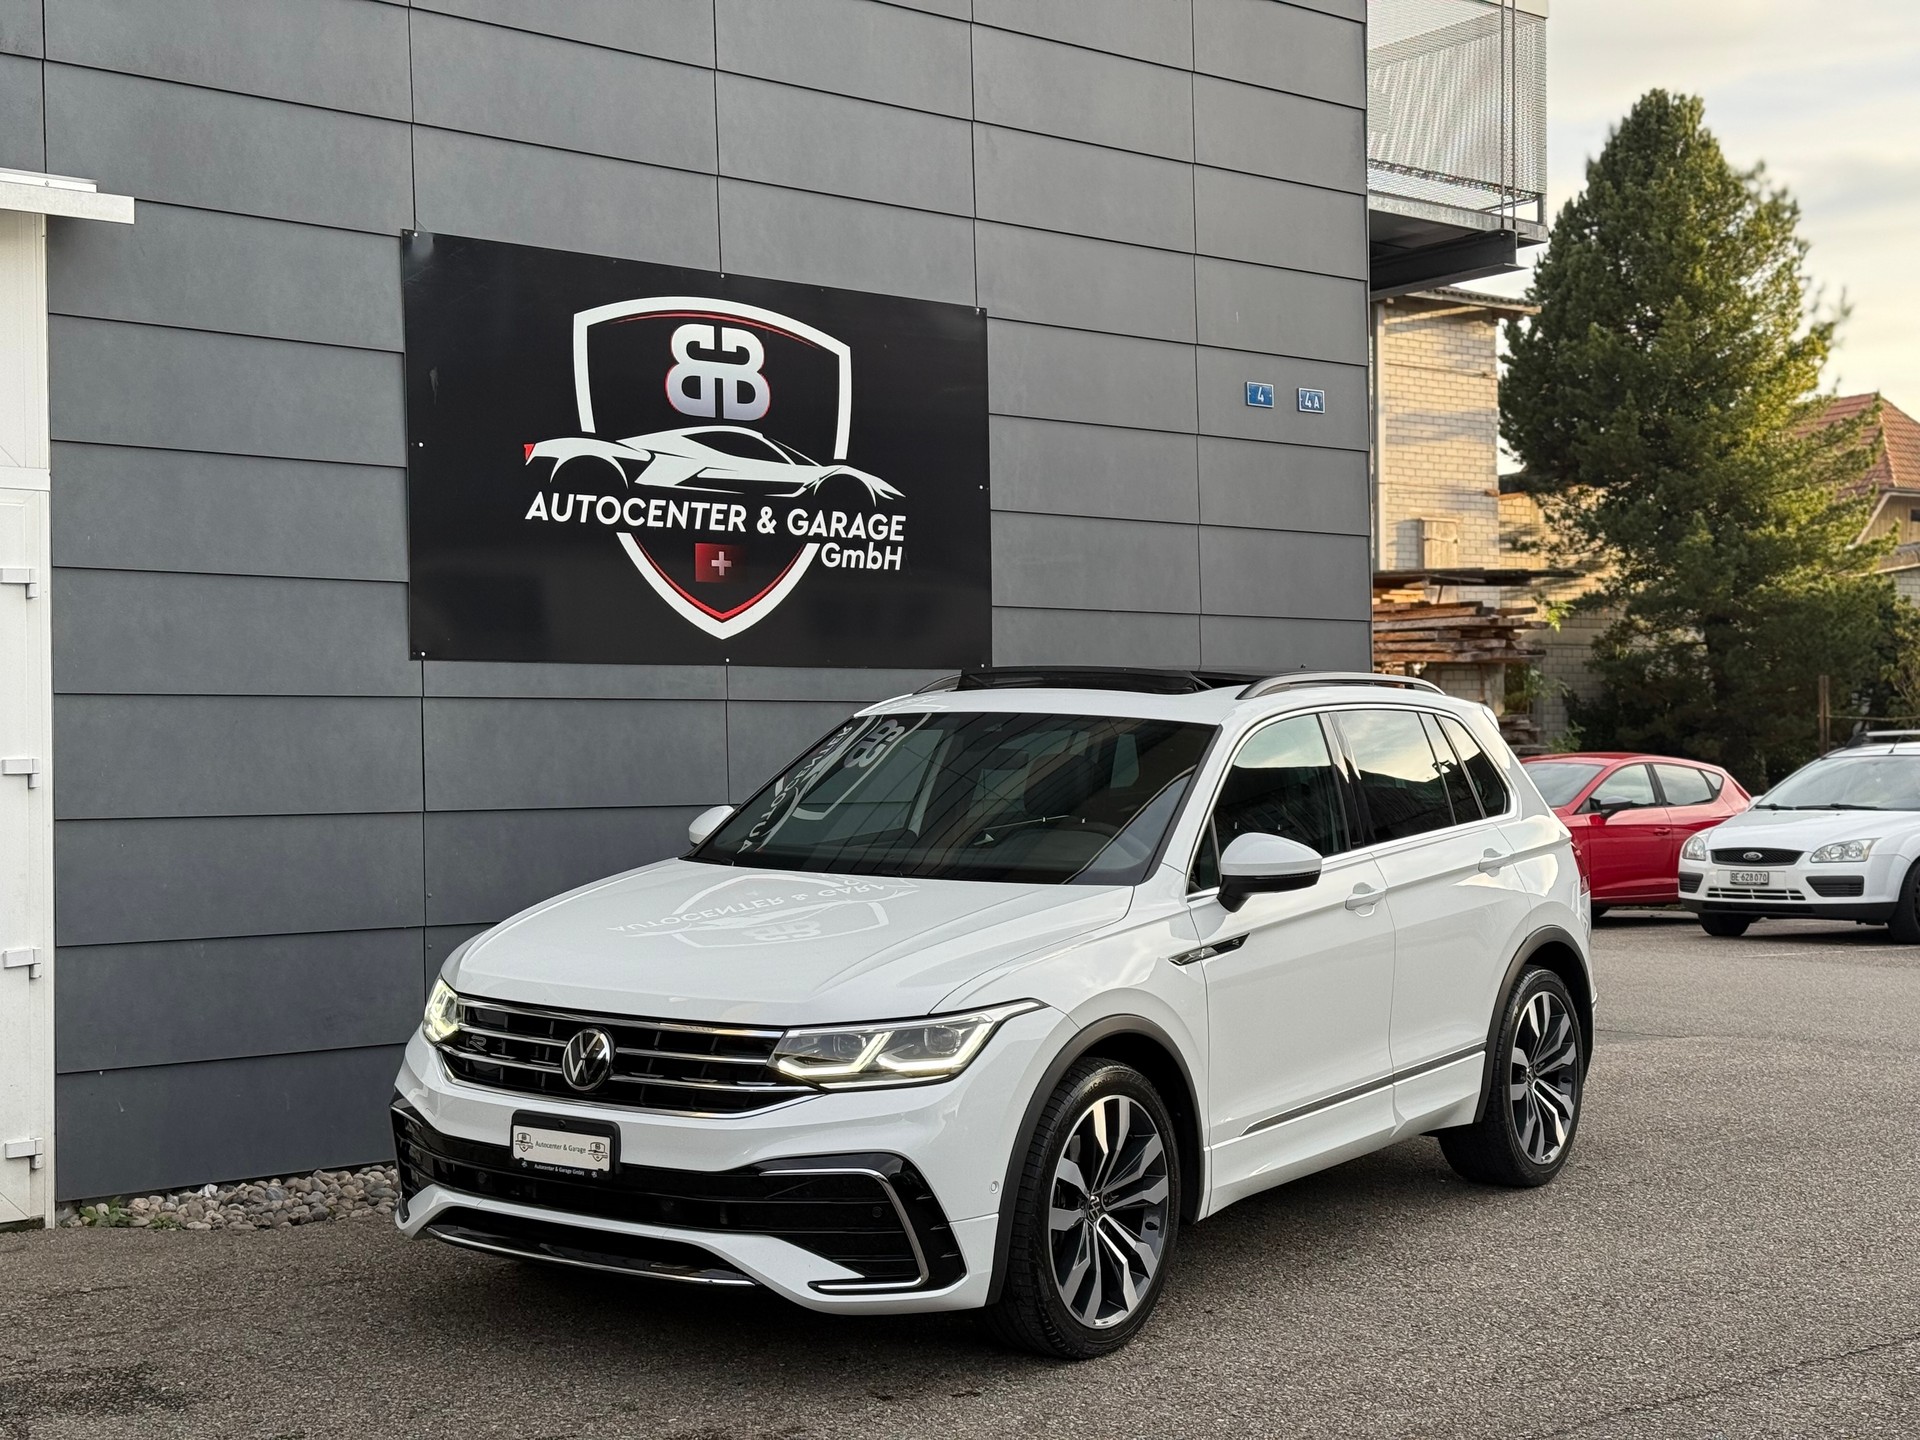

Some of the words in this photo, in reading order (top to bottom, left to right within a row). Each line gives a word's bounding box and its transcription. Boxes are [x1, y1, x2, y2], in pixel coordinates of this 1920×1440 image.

[1257, 386, 1265, 403] 4
[524, 491, 747, 532] AUTOCENTER
[756, 506, 777, 534] &
[787, 508, 906, 541] GARAGE
[821, 541, 903, 571] GmbH
[535, 1140, 562, 1150] Autocenter
[568, 1145, 586, 1154] Garage
